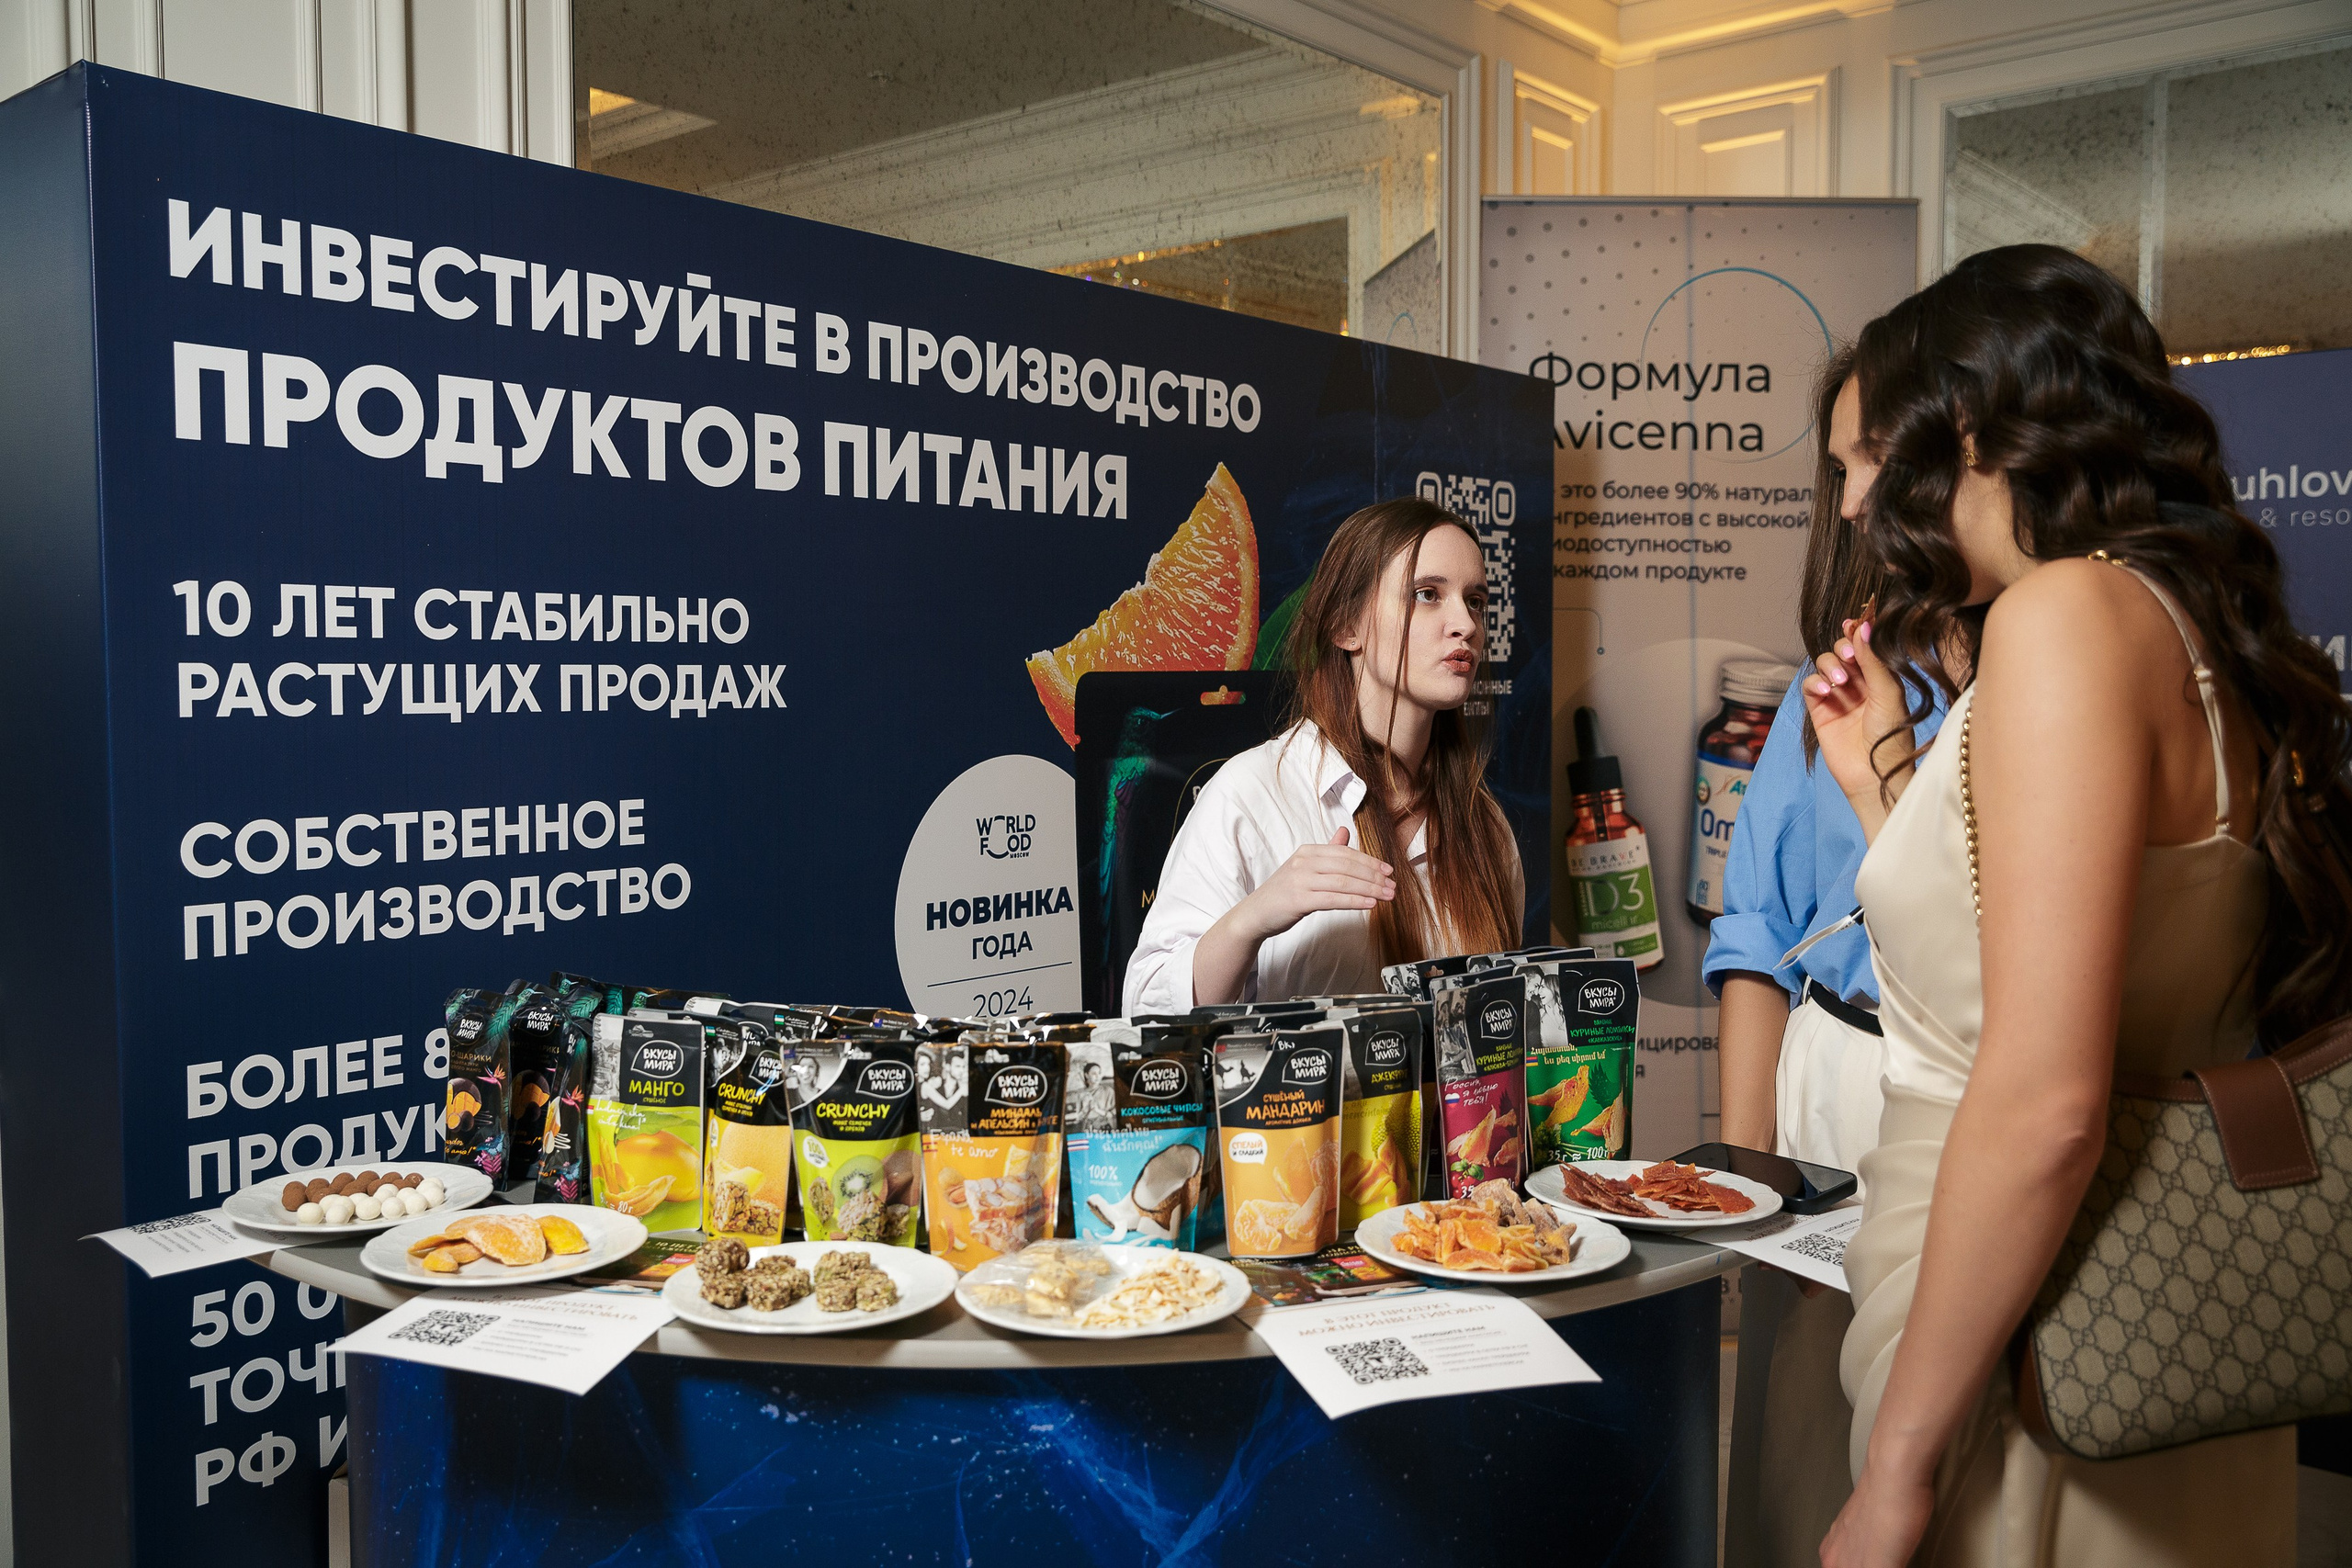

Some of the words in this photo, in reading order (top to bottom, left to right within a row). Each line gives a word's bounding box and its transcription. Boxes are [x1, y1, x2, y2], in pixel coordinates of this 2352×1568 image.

[167, 197, 797, 368] ИНВЕСТИРУЙТЕ
[815, 311, 851, 375] В
[867, 321, 1261, 434] ПРОИЗВОДСТВО
[1528, 352, 1771, 401] Формула
[173, 341, 801, 491] ПРОДУКТОВ
[823, 420, 1127, 521] ПИТАНИЯ
[1560, 483, 1597, 501] это
[1602, 480, 1669, 501] более
[1675, 481, 1720, 501] 90%
[1554, 511, 1693, 528] нгредиентов
[1699, 513, 1711, 527] с
[1716, 510, 1811, 529] высокой
[1554, 536, 1732, 557] иодоступностью
[1553, 563, 1639, 583] каждом
[1645, 564, 1747, 584] продукте
[172, 579, 252, 637] 10
[272, 582, 395, 638] ЛЕТ
[413, 588, 749, 644] СТАБИЛЬНО
[178, 661, 542, 723] РАСТУЩИХ
[560, 663, 787, 719] ПРОДАЖ
[180, 798, 645, 879] СОБСТВЕННОЕ
[184, 863, 692, 960] ПРОИЗВОДСТВО
[925, 886, 1074, 931] НОВИНКА
[971, 931, 1034, 960] ГОДА
[1585, 987, 1617, 998] ВКУСЫ
[972, 985, 1034, 1019] 2024
[1589, 997, 1616, 1009] МИРА
[1485, 1008, 1512, 1024] ВКУСЫ
[459, 1018, 483, 1032] ВКУСЫ
[526, 1020, 551, 1032] МИРА
[1489, 1020, 1513, 1033] МИРА
[1570, 1026, 1604, 1037] КУРИНЫЕ
[457, 1028, 478, 1040] МИРА
[1371, 1037, 1399, 1052] ВКУСЫ
[450, 1051, 492, 1063] О-ШАРИКИ
[643, 1048, 677, 1060] ВКУСЫ
[1374, 1048, 1400, 1062] МИРА
[1476, 1051, 1506, 1066] КУРИНЫЕ
[644, 1058, 676, 1071] МИРА
[1290, 1055, 1326, 1069] ВКУСЫ
[187, 1035, 404, 1120] БОЛЕЕ
[867, 1068, 906, 1081] ВКУСЫ
[1141, 1067, 1180, 1082] ВКУСЫ
[1295, 1066, 1327, 1079] МИРА
[628, 1079, 685, 1098] МАНГО
[870, 1078, 906, 1091] МИРА
[997, 1075, 1039, 1089] ВКУСЫ
[1144, 1079, 1180, 1092] МИРА
[718, 1082, 766, 1105] CRUNCHY
[1001, 1086, 1038, 1100] МИРА
[816, 1102, 891, 1119] CRUNCHY
[990, 1107, 1043, 1119] МИНДАЛЬ
[1120, 1104, 1171, 1117] КОКОСОВЫЕ
[1172, 1102, 1204, 1113] ЧИПСЫ
[1246, 1099, 1325, 1121] МАНДАРИН
[978, 1118, 1029, 1130] АПЕЛЬСИН
[1089, 1164, 1118, 1180] 100%
[189, 1280, 276, 1348] 50
[189, 1339, 346, 1426] ТОЧ
[195, 1429, 297, 1507] РФ
